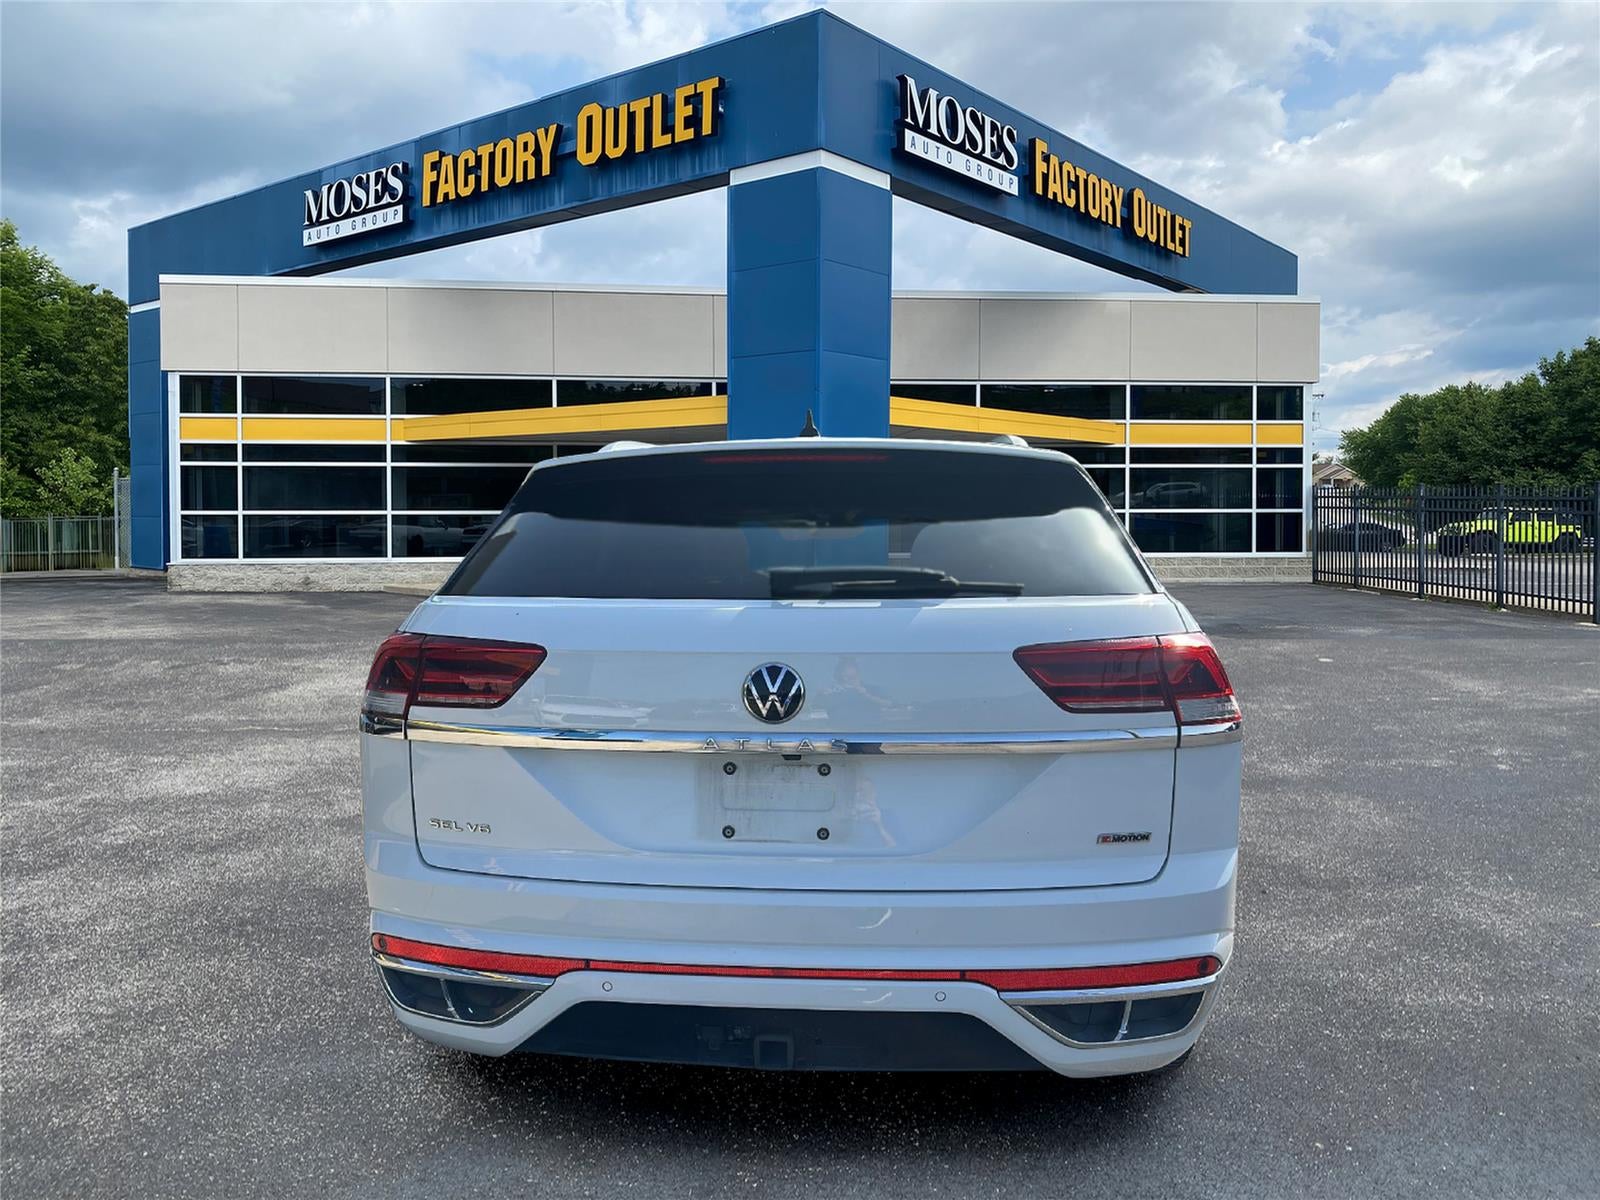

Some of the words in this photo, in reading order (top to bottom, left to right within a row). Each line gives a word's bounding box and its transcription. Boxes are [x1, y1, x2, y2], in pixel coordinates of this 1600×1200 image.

[422, 124, 559, 207] FACTORY
[576, 76, 721, 167] OUTLET
[904, 74, 1018, 170] MOSES
[910, 135, 953, 164] AUTO
[965, 158, 1014, 188] GROUP
[303, 162, 404, 226] MOSES
[1035, 137, 1124, 228] FACTORY
[1132, 187, 1192, 257] OUTLET
[307, 223, 341, 242] AUTO
[350, 208, 399, 233] GROUP
[702, 737, 848, 751] ATLAS
[428, 818, 463, 832] SEL
[466, 822, 491, 834] V6
